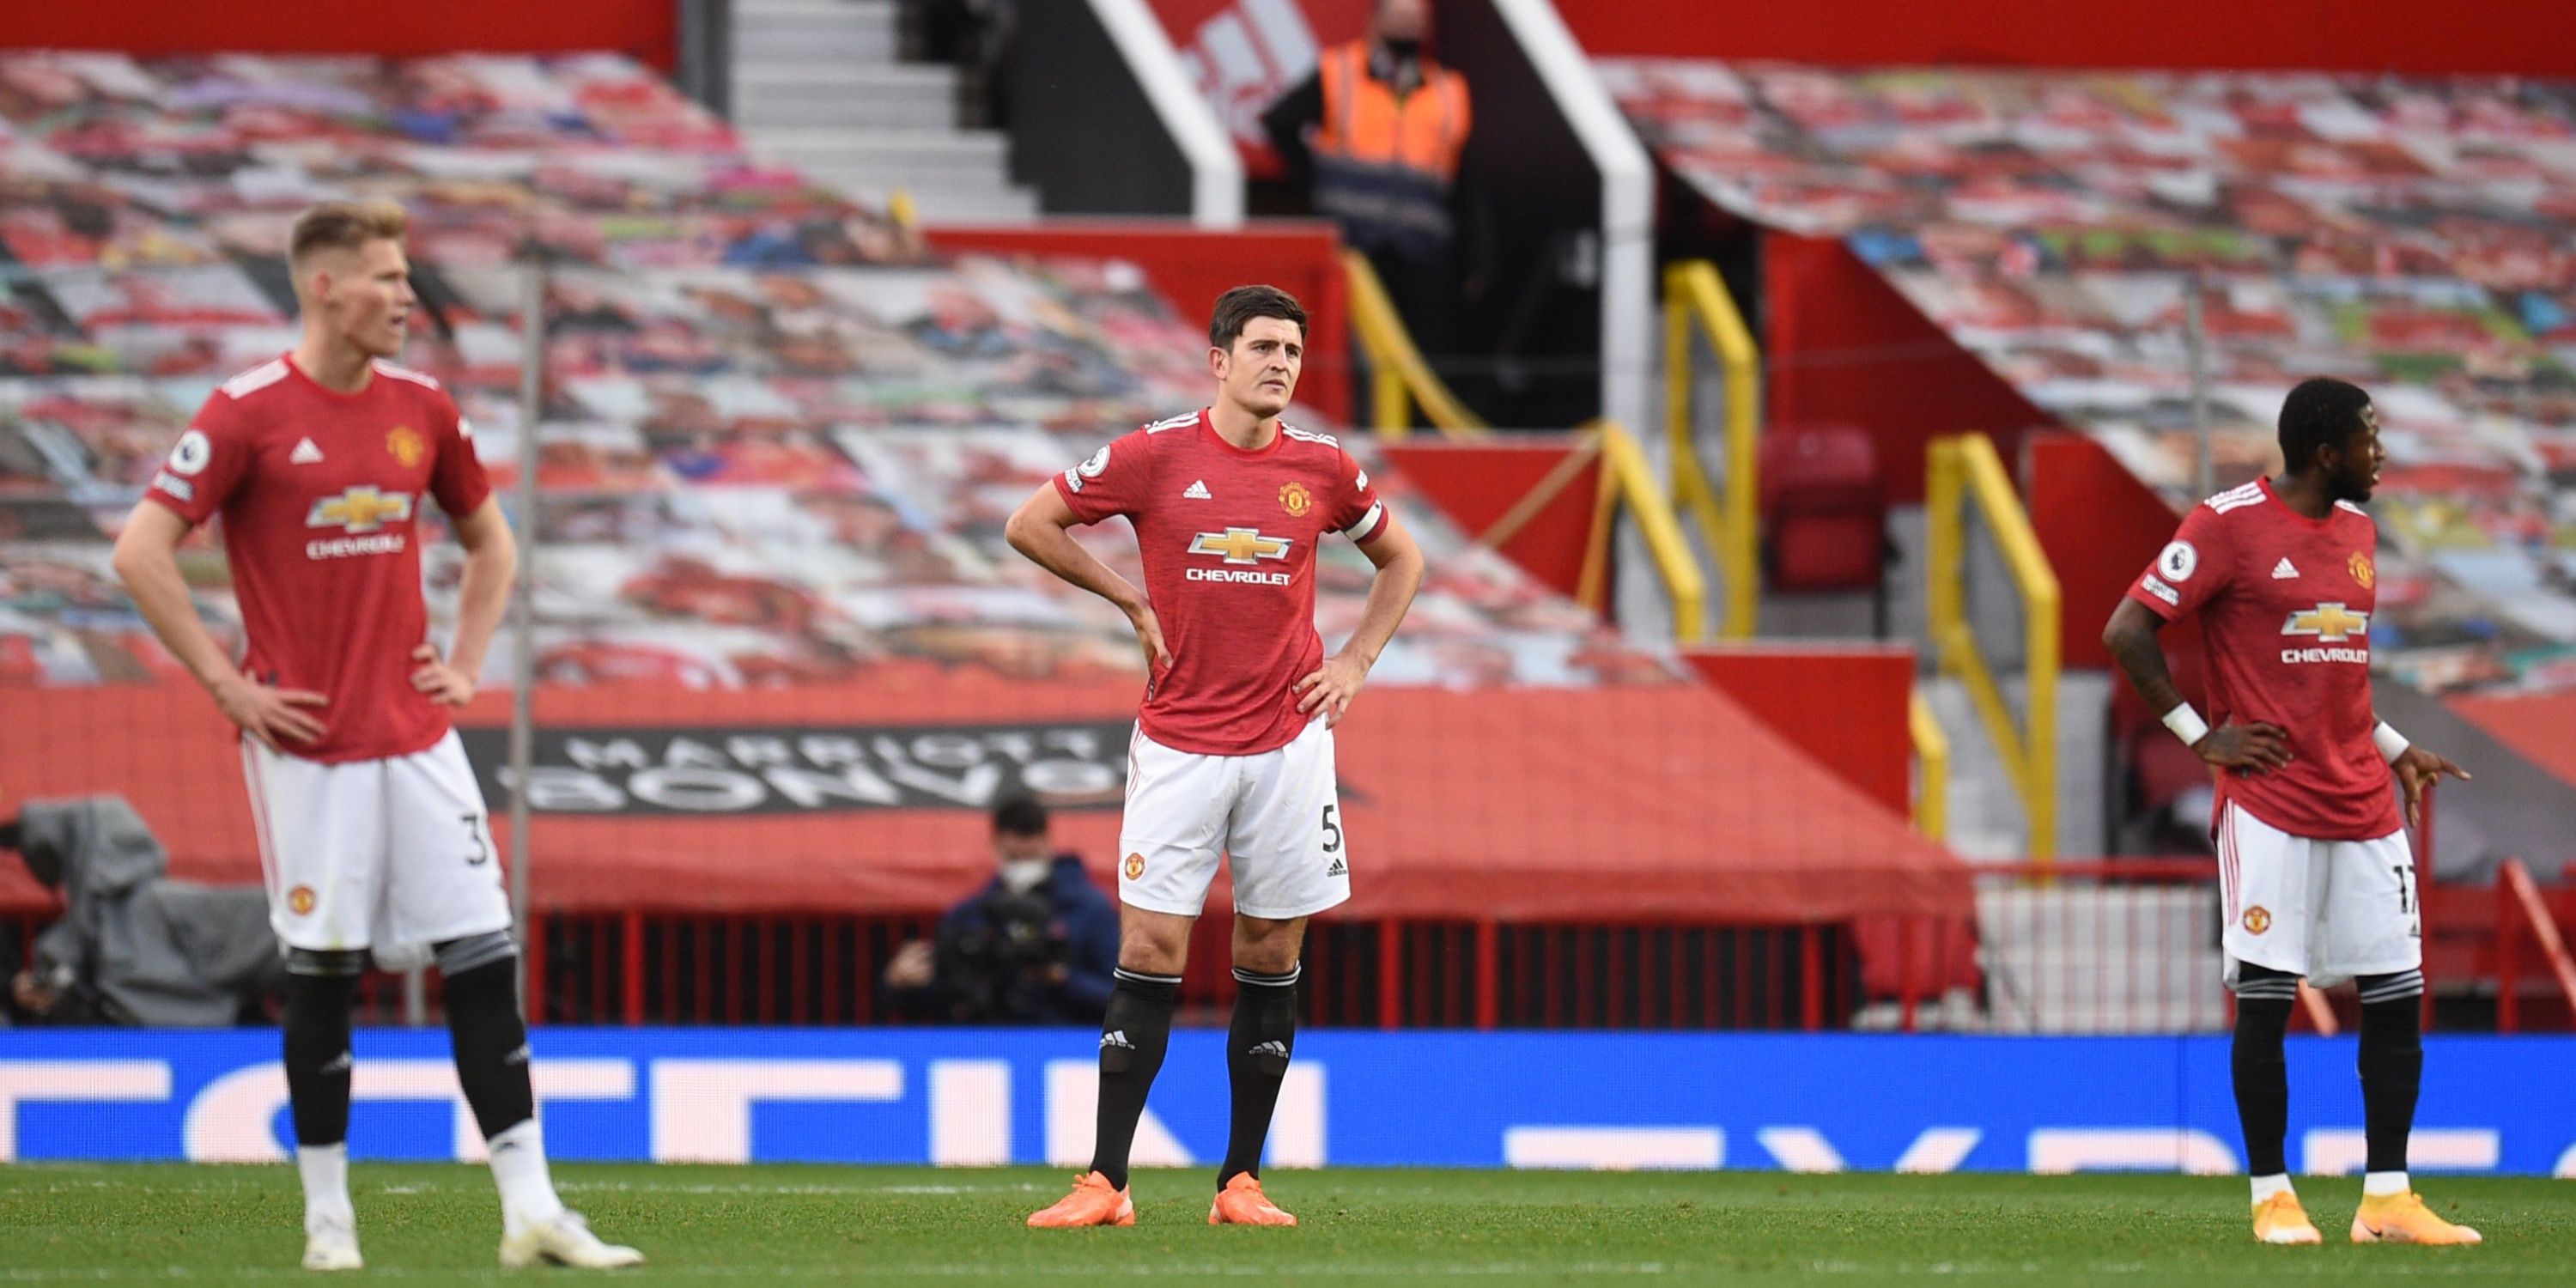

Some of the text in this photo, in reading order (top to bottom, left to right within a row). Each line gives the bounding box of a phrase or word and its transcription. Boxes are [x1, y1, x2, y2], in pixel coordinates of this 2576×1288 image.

[1186, 568, 1291, 586] CHEVROLET
[2281, 647, 2368, 664] CHEVROLET
[563, 729, 1098, 770] MARRIOTT
[496, 756, 1127, 811] BONVO
[1322, 804, 1340, 853] 5
